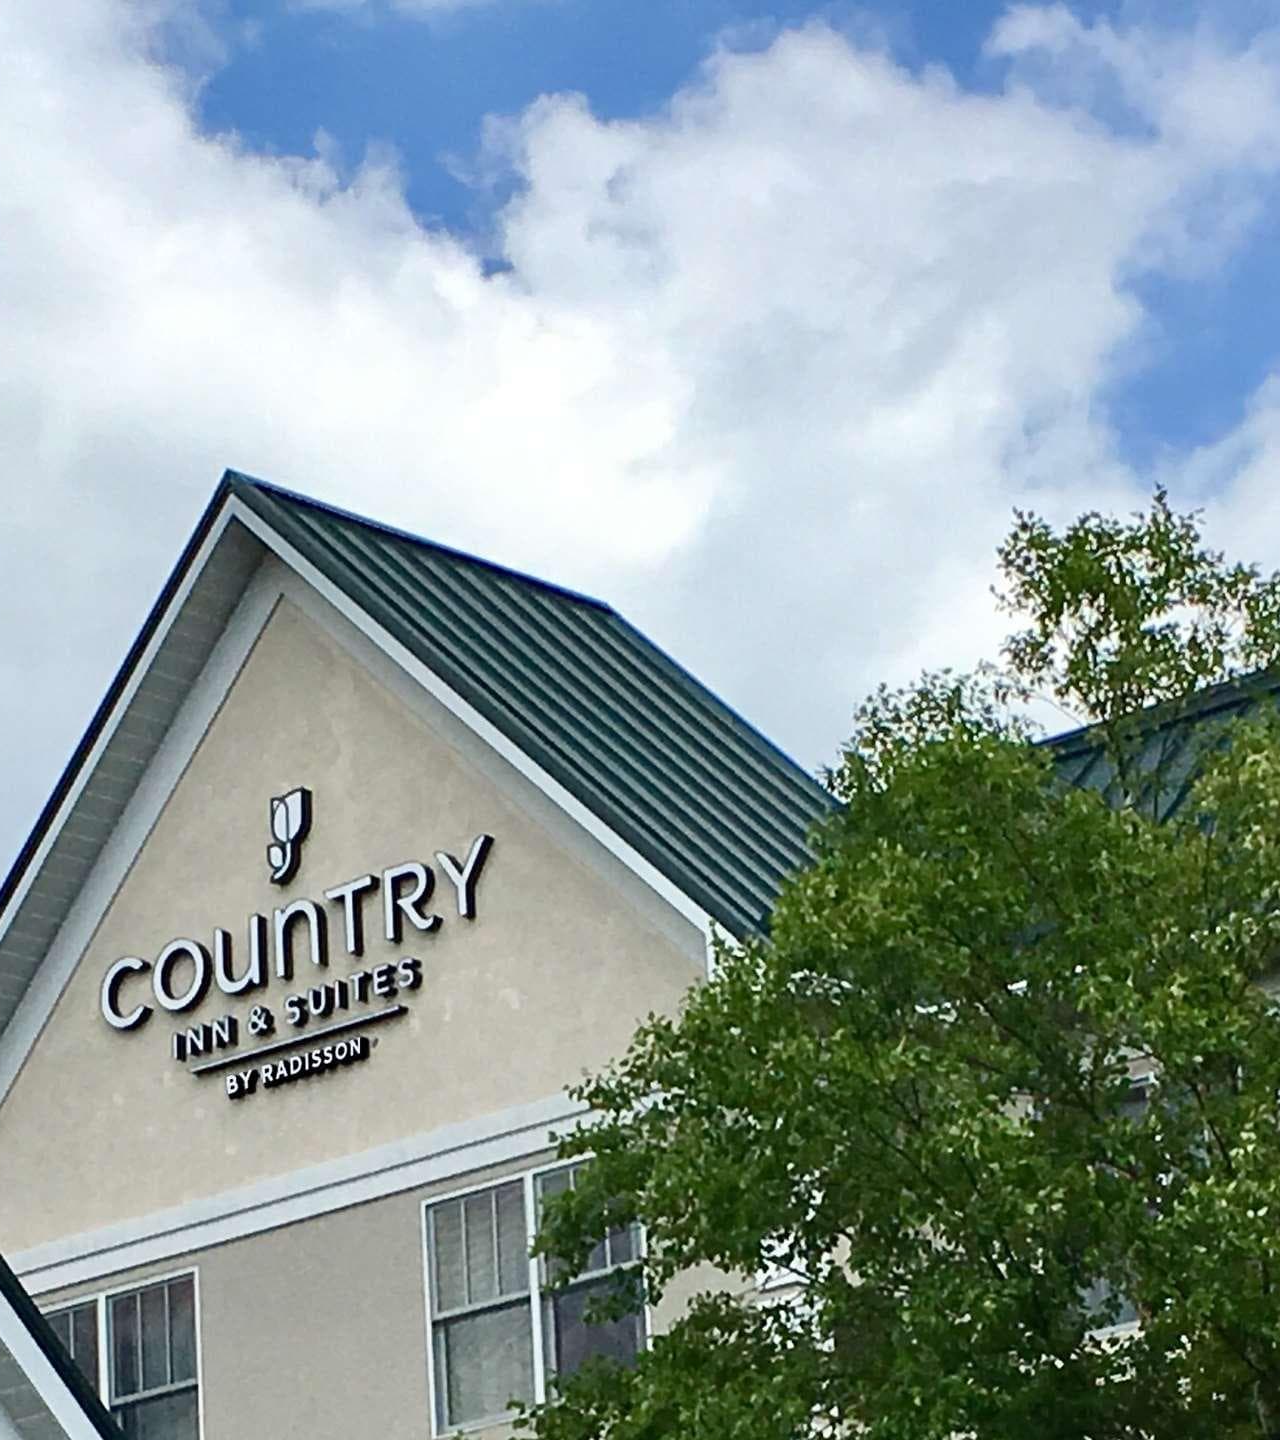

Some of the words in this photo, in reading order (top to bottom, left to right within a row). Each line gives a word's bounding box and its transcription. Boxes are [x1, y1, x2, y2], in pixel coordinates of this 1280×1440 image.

[172, 1015, 238, 1061] INN
[247, 1005, 274, 1036] &
[285, 957, 422, 1027] SUITES
[225, 1071, 258, 1099] BY
[260, 1036, 372, 1088] RADISSON
